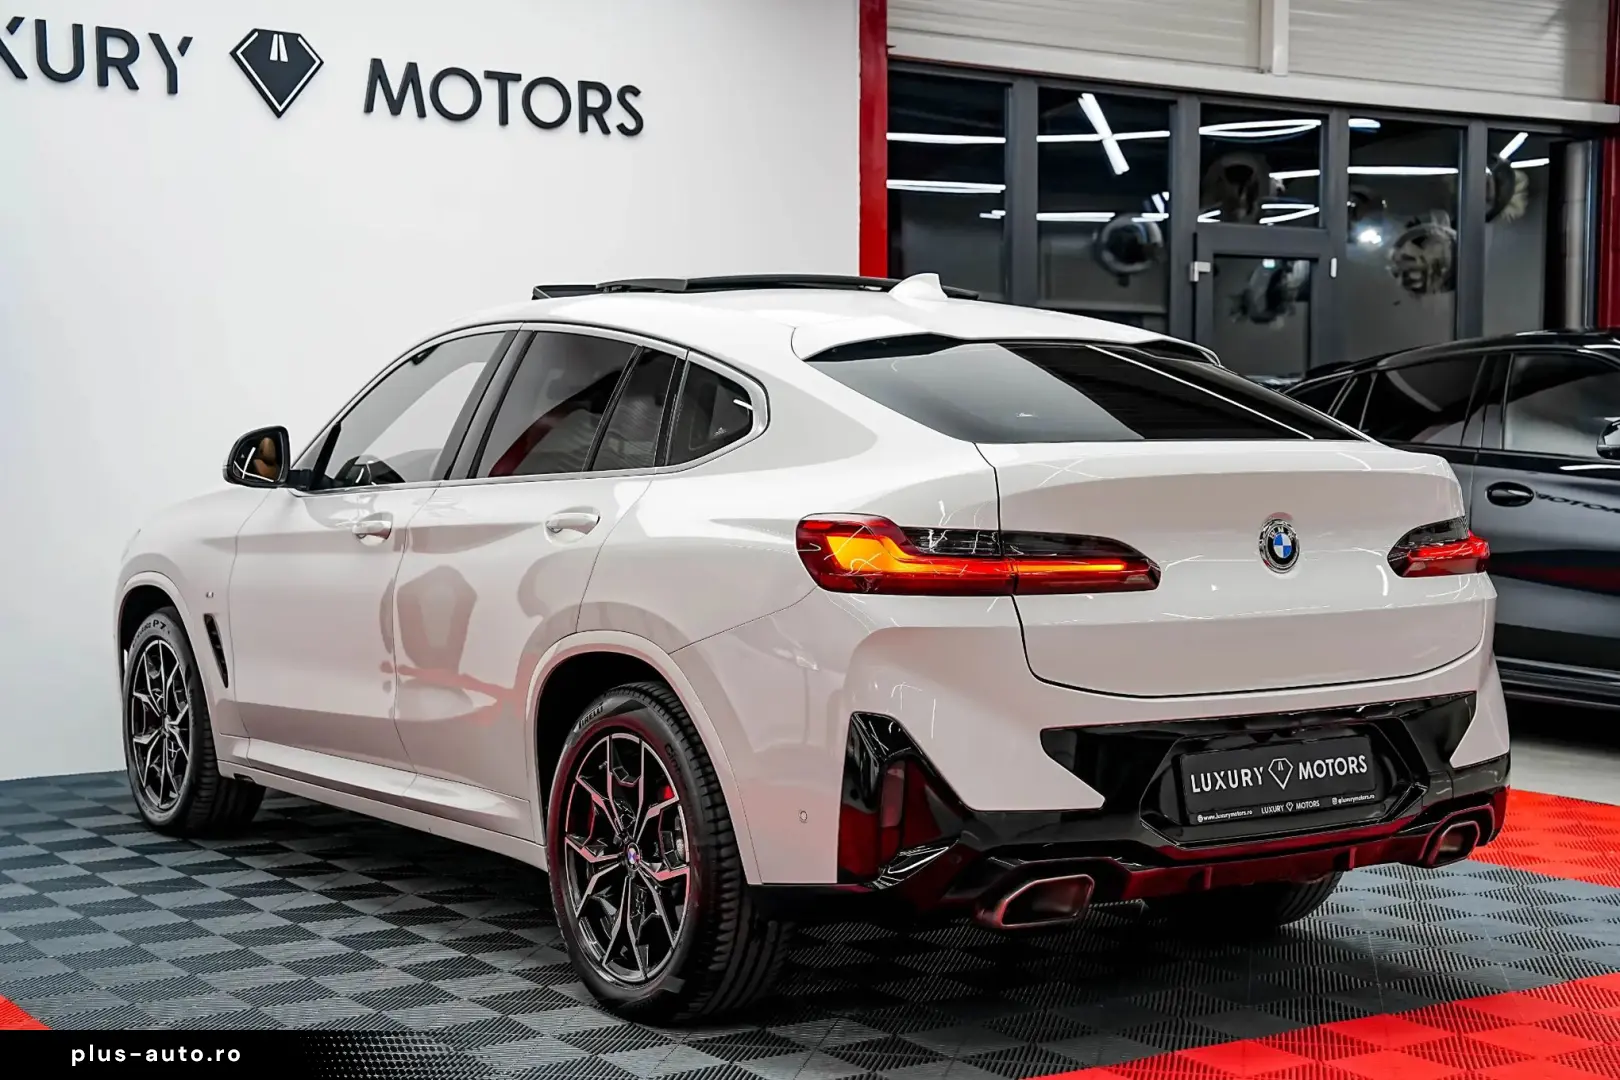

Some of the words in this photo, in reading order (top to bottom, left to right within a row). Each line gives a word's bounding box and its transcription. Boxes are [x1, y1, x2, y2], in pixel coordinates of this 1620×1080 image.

[364, 58, 644, 137] MOTORS
[1190, 766, 1264, 793] LUXURY
[1299, 754, 1368, 781] MOTORS
[1261, 804, 1285, 815] LUXURY
[1296, 799, 1320, 810] MOTORS
